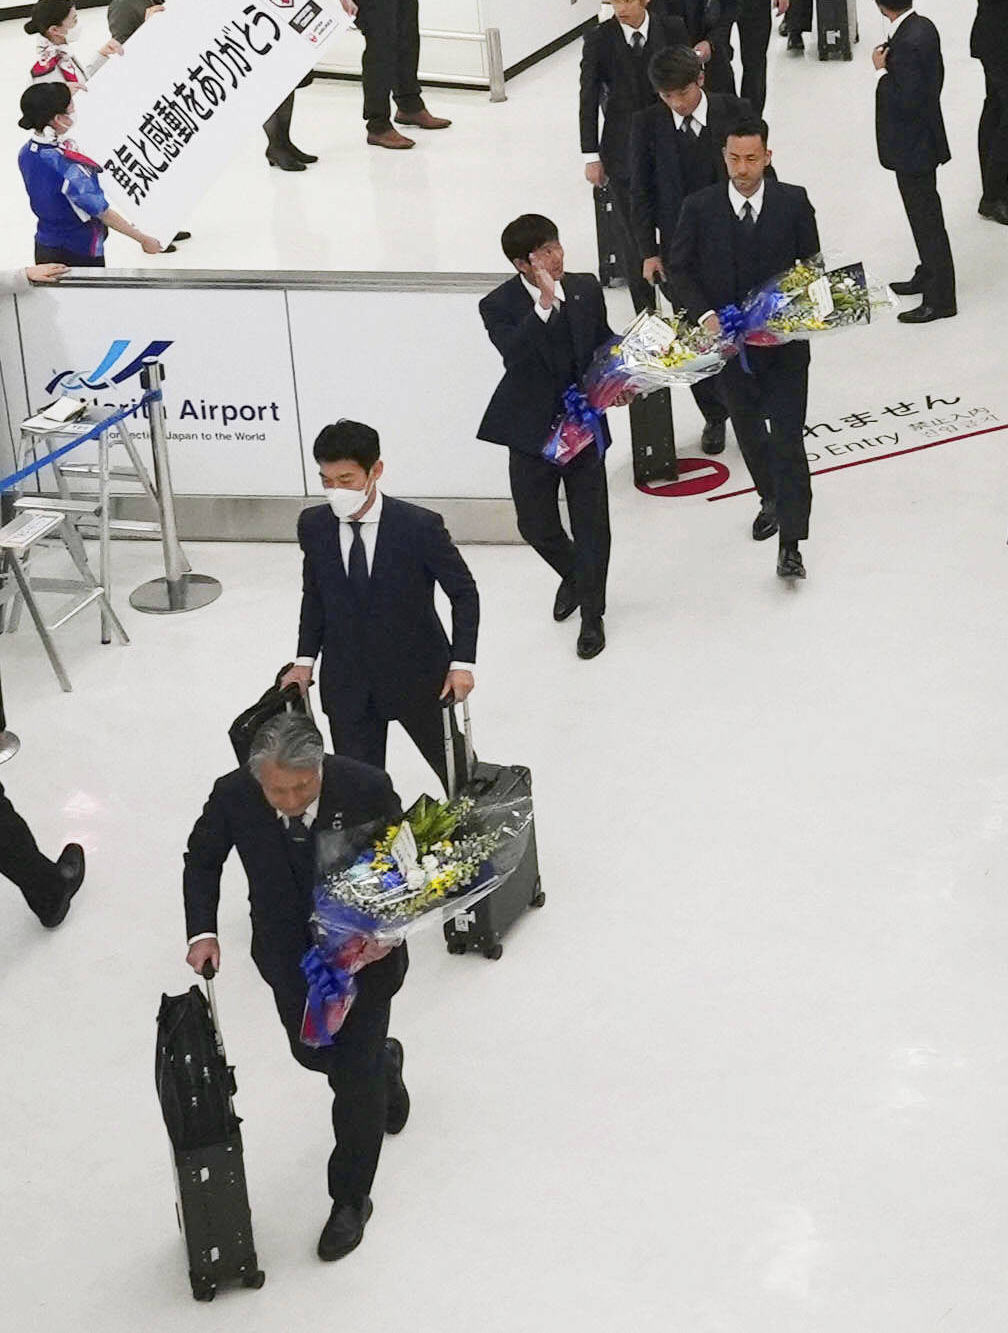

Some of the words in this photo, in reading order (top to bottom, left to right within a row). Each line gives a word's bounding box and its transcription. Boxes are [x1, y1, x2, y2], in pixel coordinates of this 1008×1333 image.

[103, 4, 281, 206] 勇気と感動をありがとう
[179, 399, 281, 426] Airport
[166, 431, 198, 444] Japan
[201, 431, 213, 441] to
[216, 430, 233, 441] the
[236, 430, 266, 441] World
[825, 432, 899, 457] Entry
